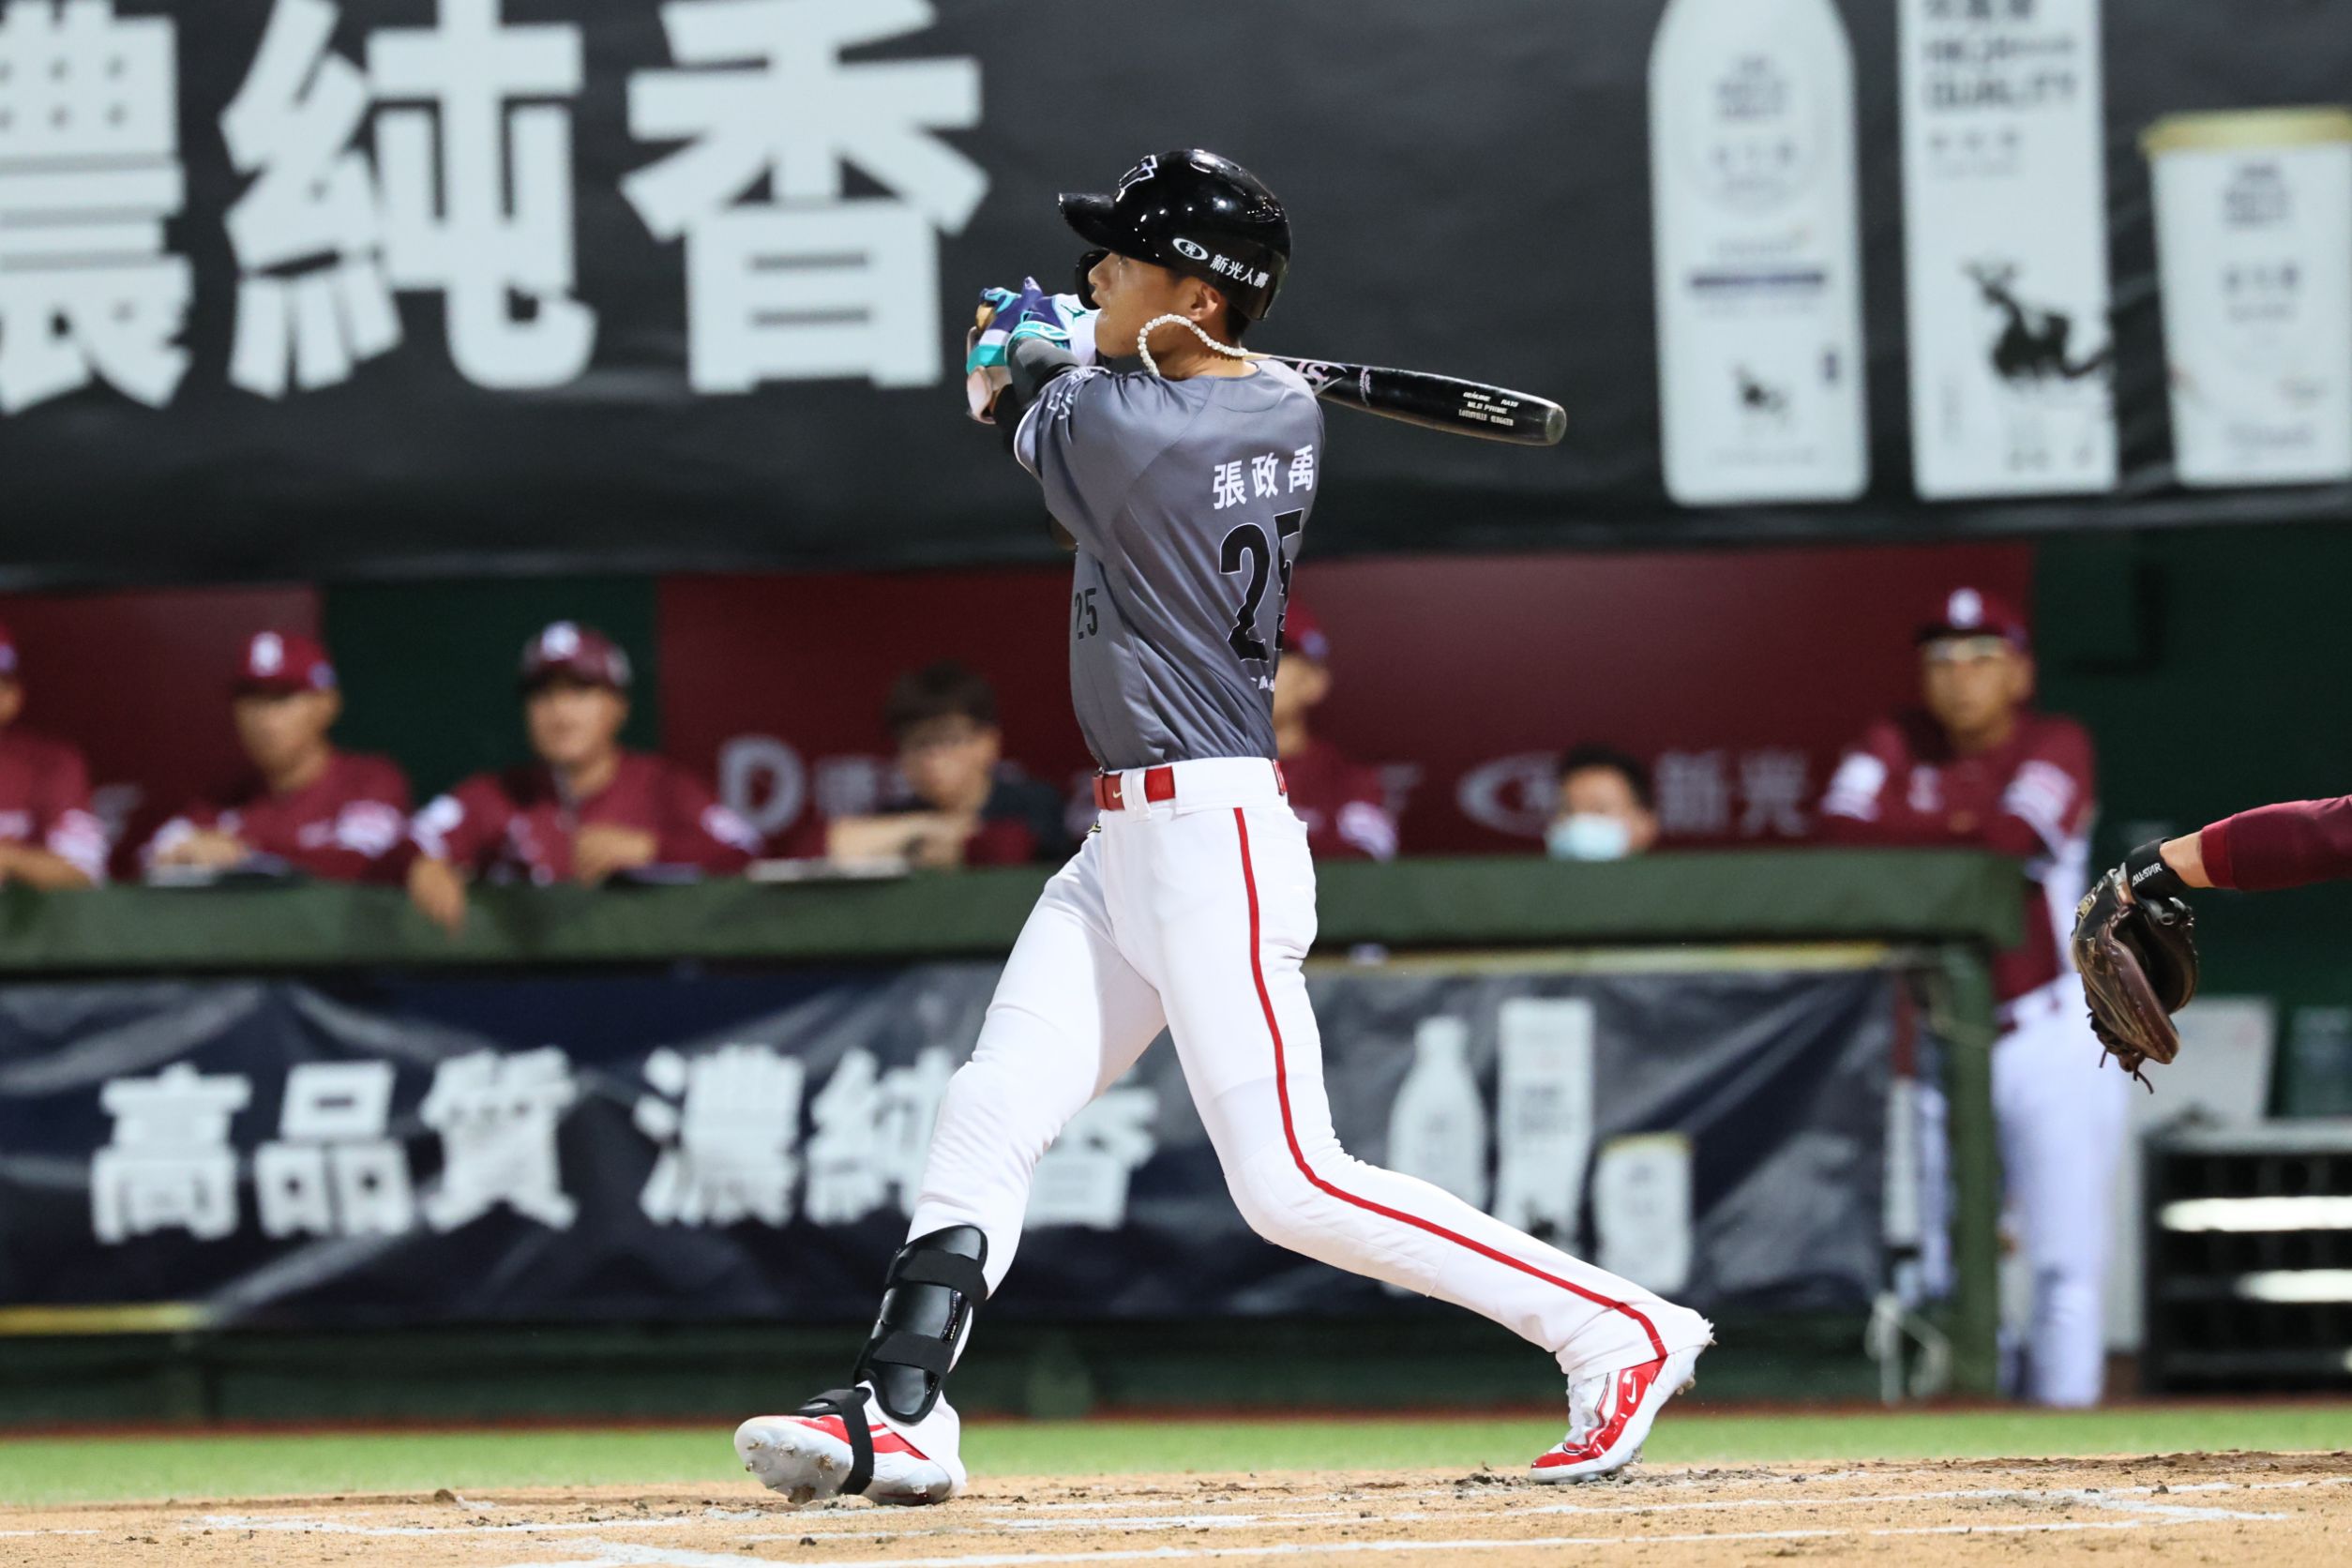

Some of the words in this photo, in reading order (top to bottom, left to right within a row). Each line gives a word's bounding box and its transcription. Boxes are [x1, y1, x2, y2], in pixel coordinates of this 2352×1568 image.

[1210, 253, 1270, 289] 新光人壽
[1484, 403, 1508, 414] PRIME
[1212, 444, 1314, 509] 張政禹
[1075, 587, 1098, 640] 25
[90, 1045, 579, 1244] 高品質
